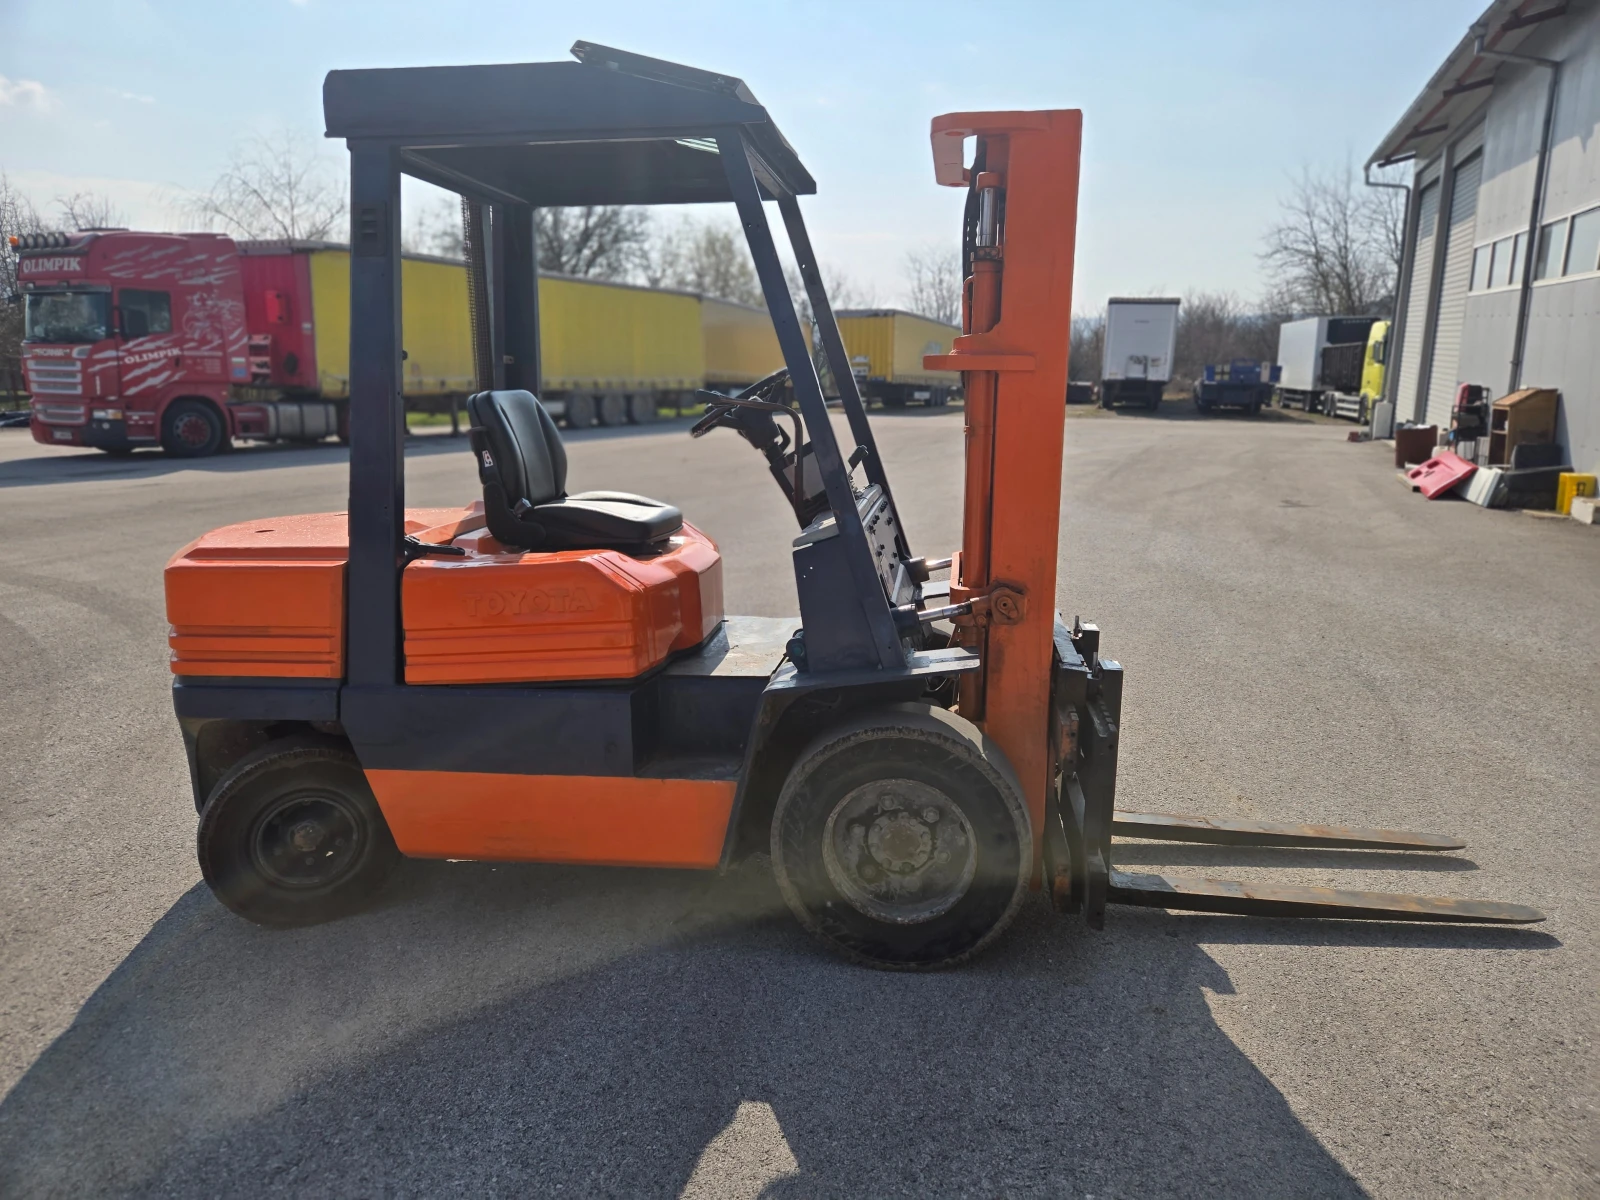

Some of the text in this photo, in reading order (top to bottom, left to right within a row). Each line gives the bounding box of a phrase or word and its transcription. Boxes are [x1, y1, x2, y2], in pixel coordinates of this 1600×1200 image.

[23, 257, 81, 273] OLIMPIK
[124, 347, 181, 364] OLIMPIK
[464, 587, 595, 617] TOYOTA
